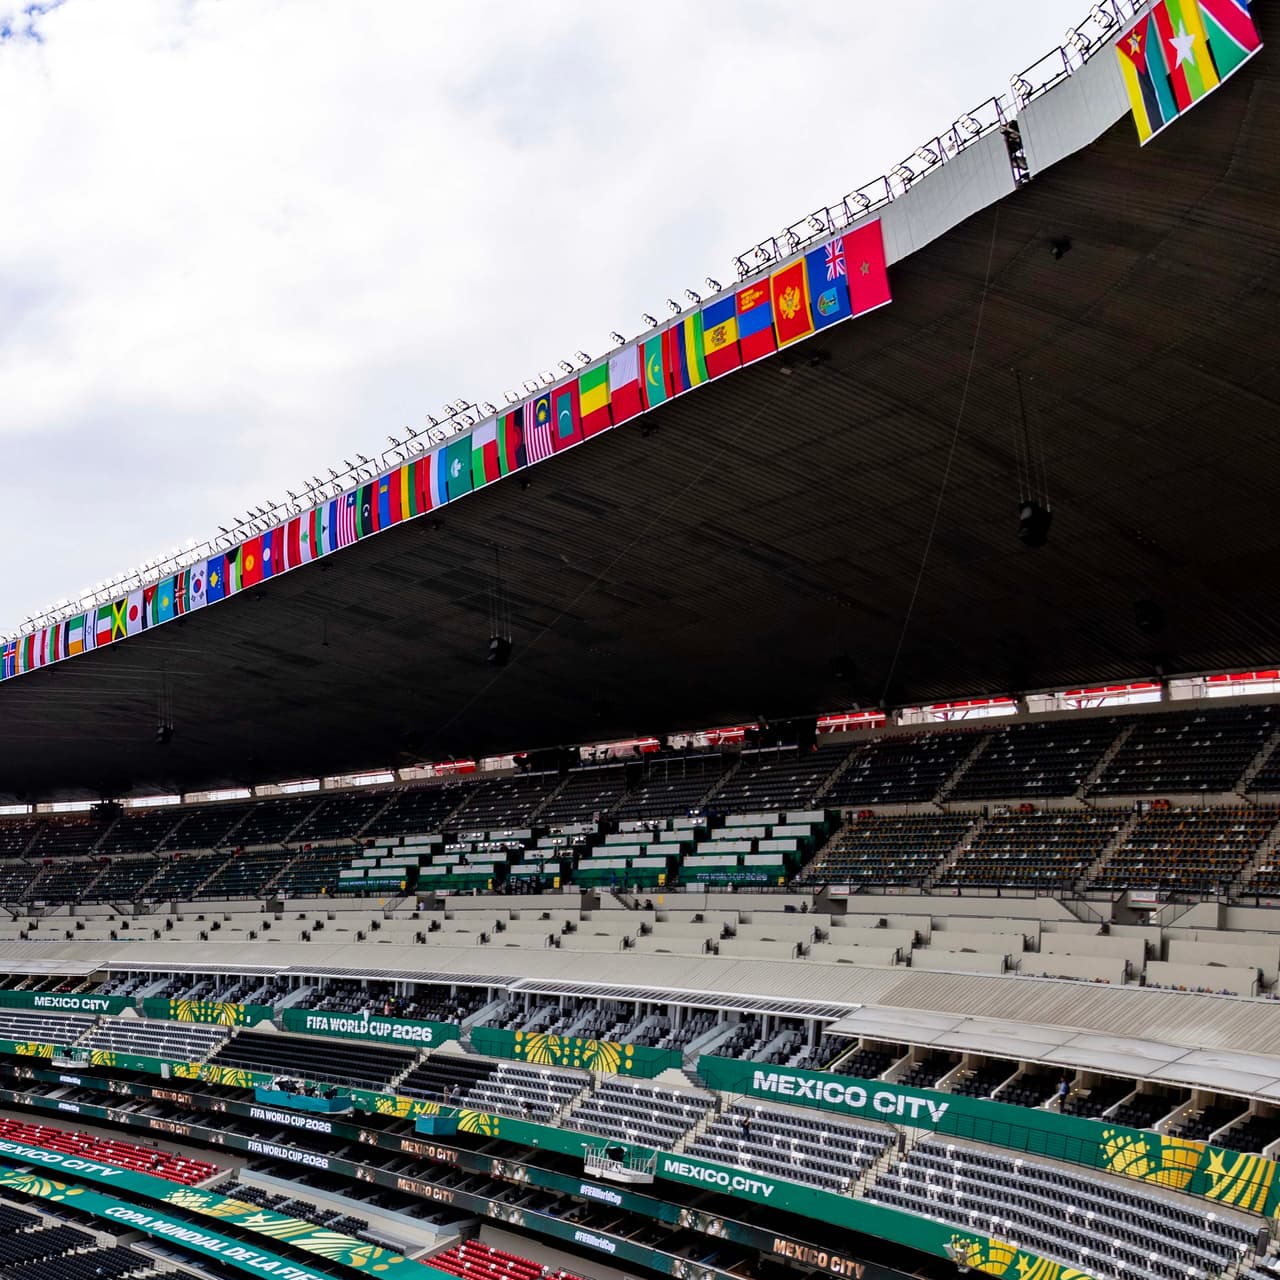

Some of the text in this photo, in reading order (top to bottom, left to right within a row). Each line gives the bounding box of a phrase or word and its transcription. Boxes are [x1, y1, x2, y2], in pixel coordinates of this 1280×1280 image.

[34, 996, 110, 1011] MEXICO CITY
[306, 1015, 432, 1041] FIFA WORLD CUP 2026
[752, 1070, 949, 1121] MEXICO CITY
[250, 1108, 332, 1133] FIFA WORLD CUP 2026
[401, 1139, 458, 1163] MEXICO CITY
[59, 1157, 123, 1178] CITY
[664, 1159, 774, 1198] MEXICO CITY
[104, 1207, 150, 1226] COPA
[145, 1219, 225, 1252] MUNDIAL
[223, 1246, 257, 1262] DE
[247, 1255, 281, 1272] LA
[773, 1238, 866, 1279] MEXICO CITY
